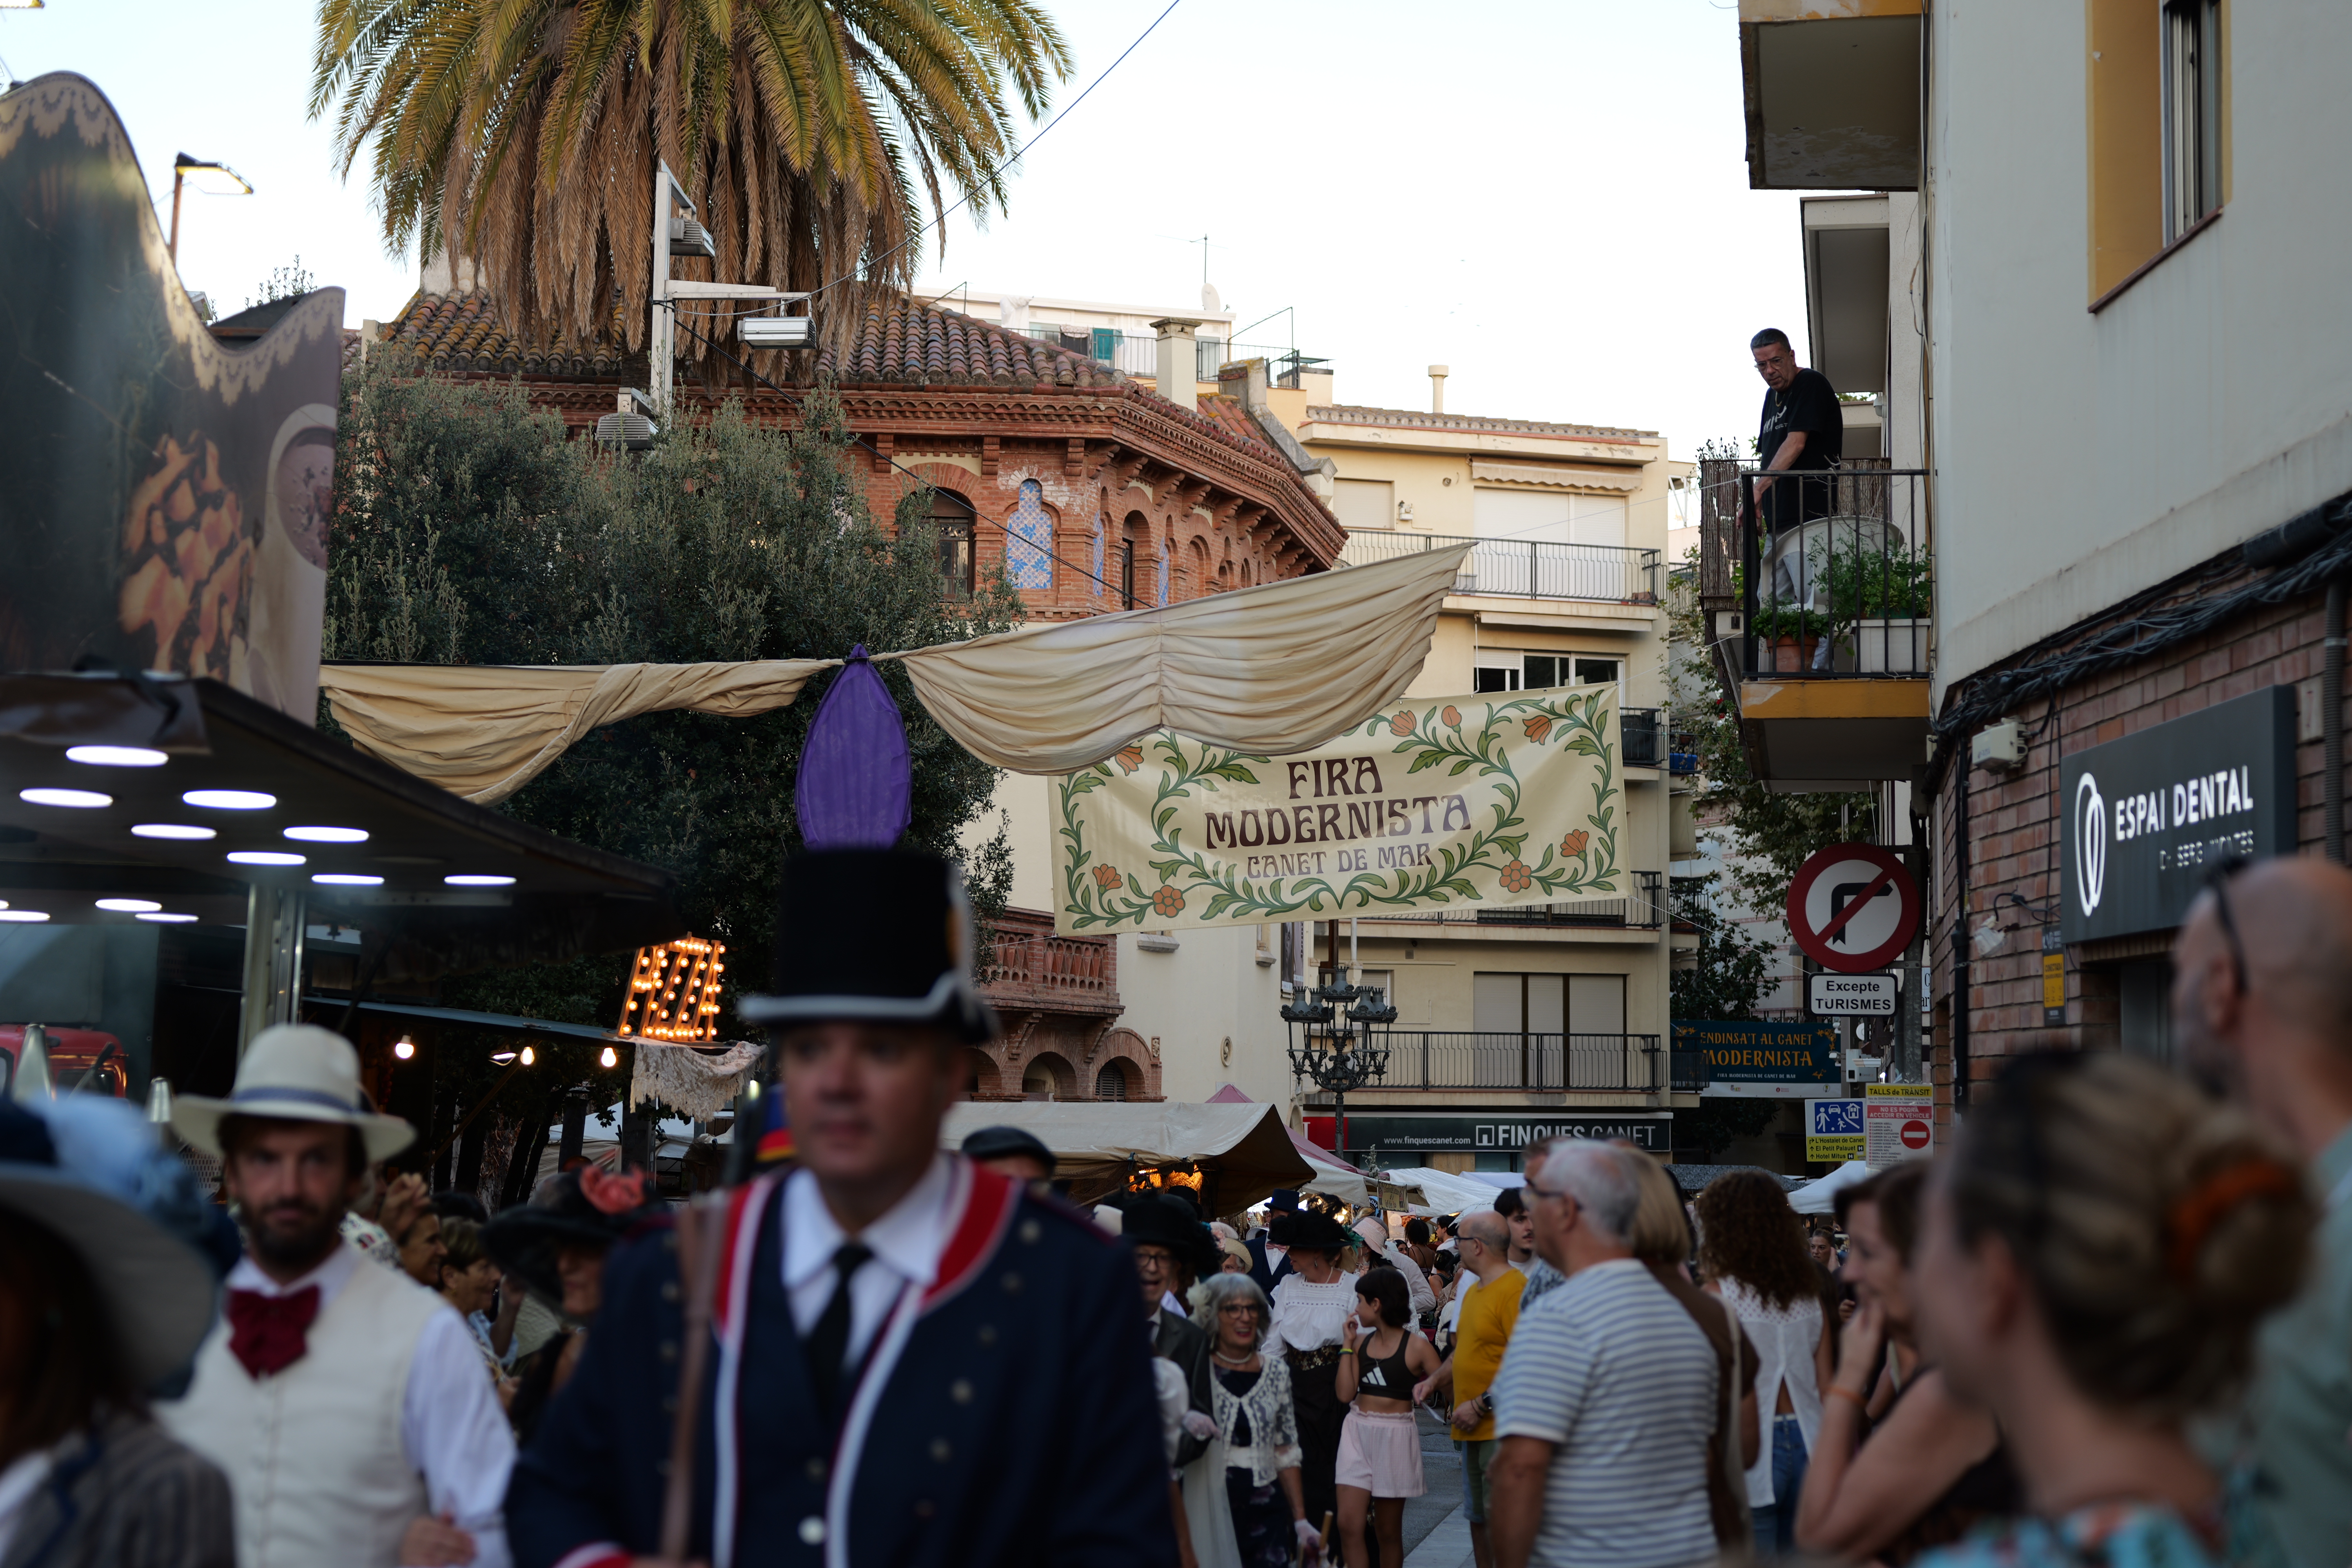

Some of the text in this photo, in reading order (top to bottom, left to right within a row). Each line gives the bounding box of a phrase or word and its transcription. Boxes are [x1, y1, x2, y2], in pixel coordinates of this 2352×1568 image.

[1286, 756, 1383, 799] FIRA
[2116, 764, 2254, 841] ESPAI DENTAL
[1205, 794, 1471, 850] MODERNISTA
[1247, 844, 1432, 878] CANET DE MAR
[1826, 980, 1880, 994] Excepte
[1815, 998, 1891, 1011] TURISMES
[1700, 1032, 1813, 1045] ENDINSA'T AL CANET
[1700, 1049, 1813, 1068] MODERNISTA
[1901, 1087, 1930, 1096] TRÀNSIT
[1384, 1135, 1471, 1146] www.finquescanet.com
